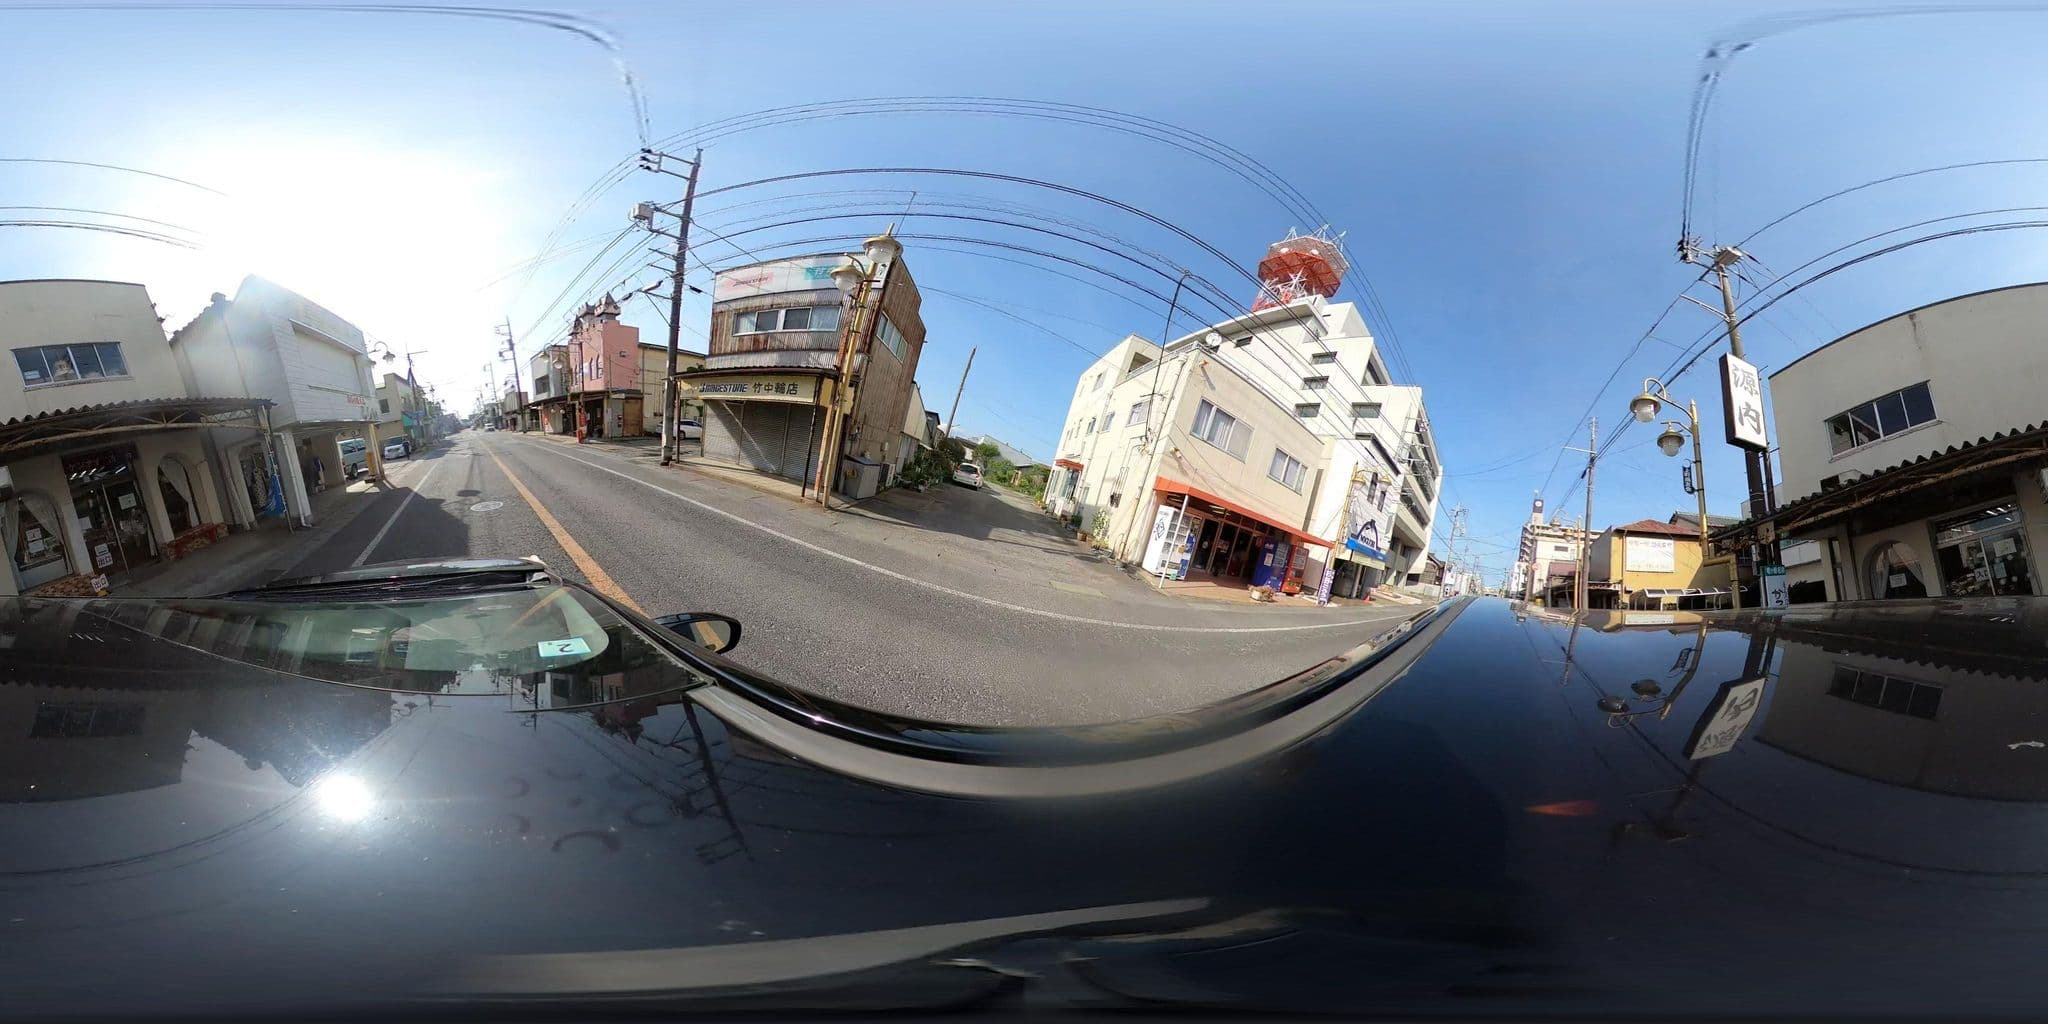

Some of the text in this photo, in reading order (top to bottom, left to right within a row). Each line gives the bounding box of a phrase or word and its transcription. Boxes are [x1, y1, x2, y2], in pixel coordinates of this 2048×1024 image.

[752, 382, 799, 395] 竹中輪店
[1732, 364, 1760, 435] 源内
